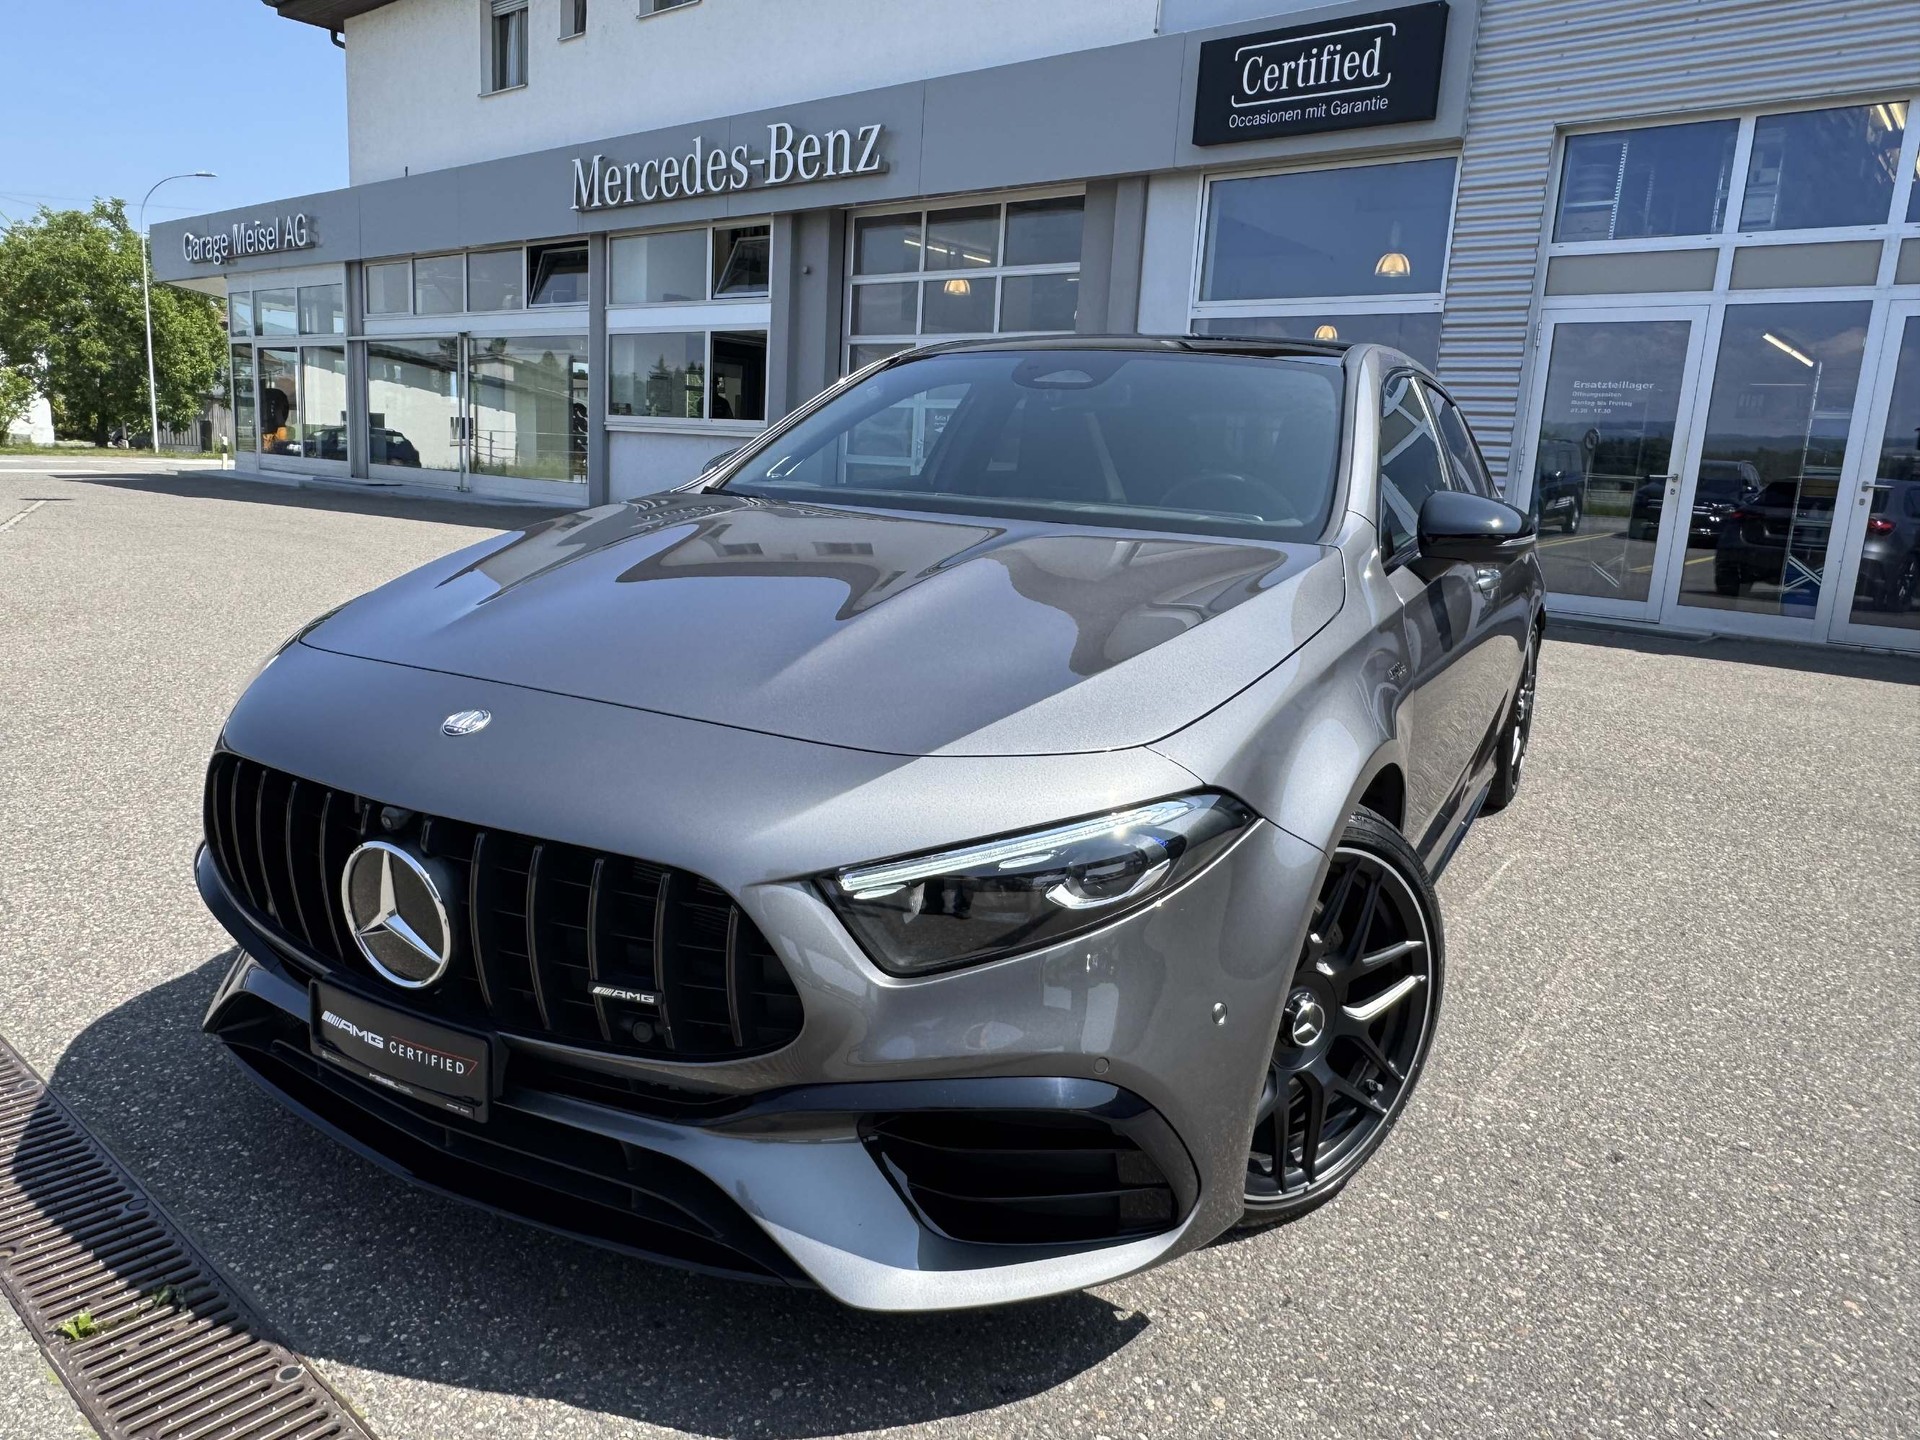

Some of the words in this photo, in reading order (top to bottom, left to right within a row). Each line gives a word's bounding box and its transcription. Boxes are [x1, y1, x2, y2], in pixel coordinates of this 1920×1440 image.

[1242, 36, 1382, 95] Certified
[1228, 108, 1301, 128] Occasionen
[1305, 103, 1326, 119] mit
[1330, 95, 1389, 116] Garantie
[569, 122, 882, 210] Mercedes-Benz
[182, 232, 228, 265] Garage
[232, 217, 279, 255] Meisel
[284, 213, 306, 248] AG
[1573, 381, 1655, 391] Ersatzteillager
[612, 989, 655, 1004] AMG
[337, 1020, 384, 1049] AMG
[389, 1041, 465, 1074] CERTIFIED
